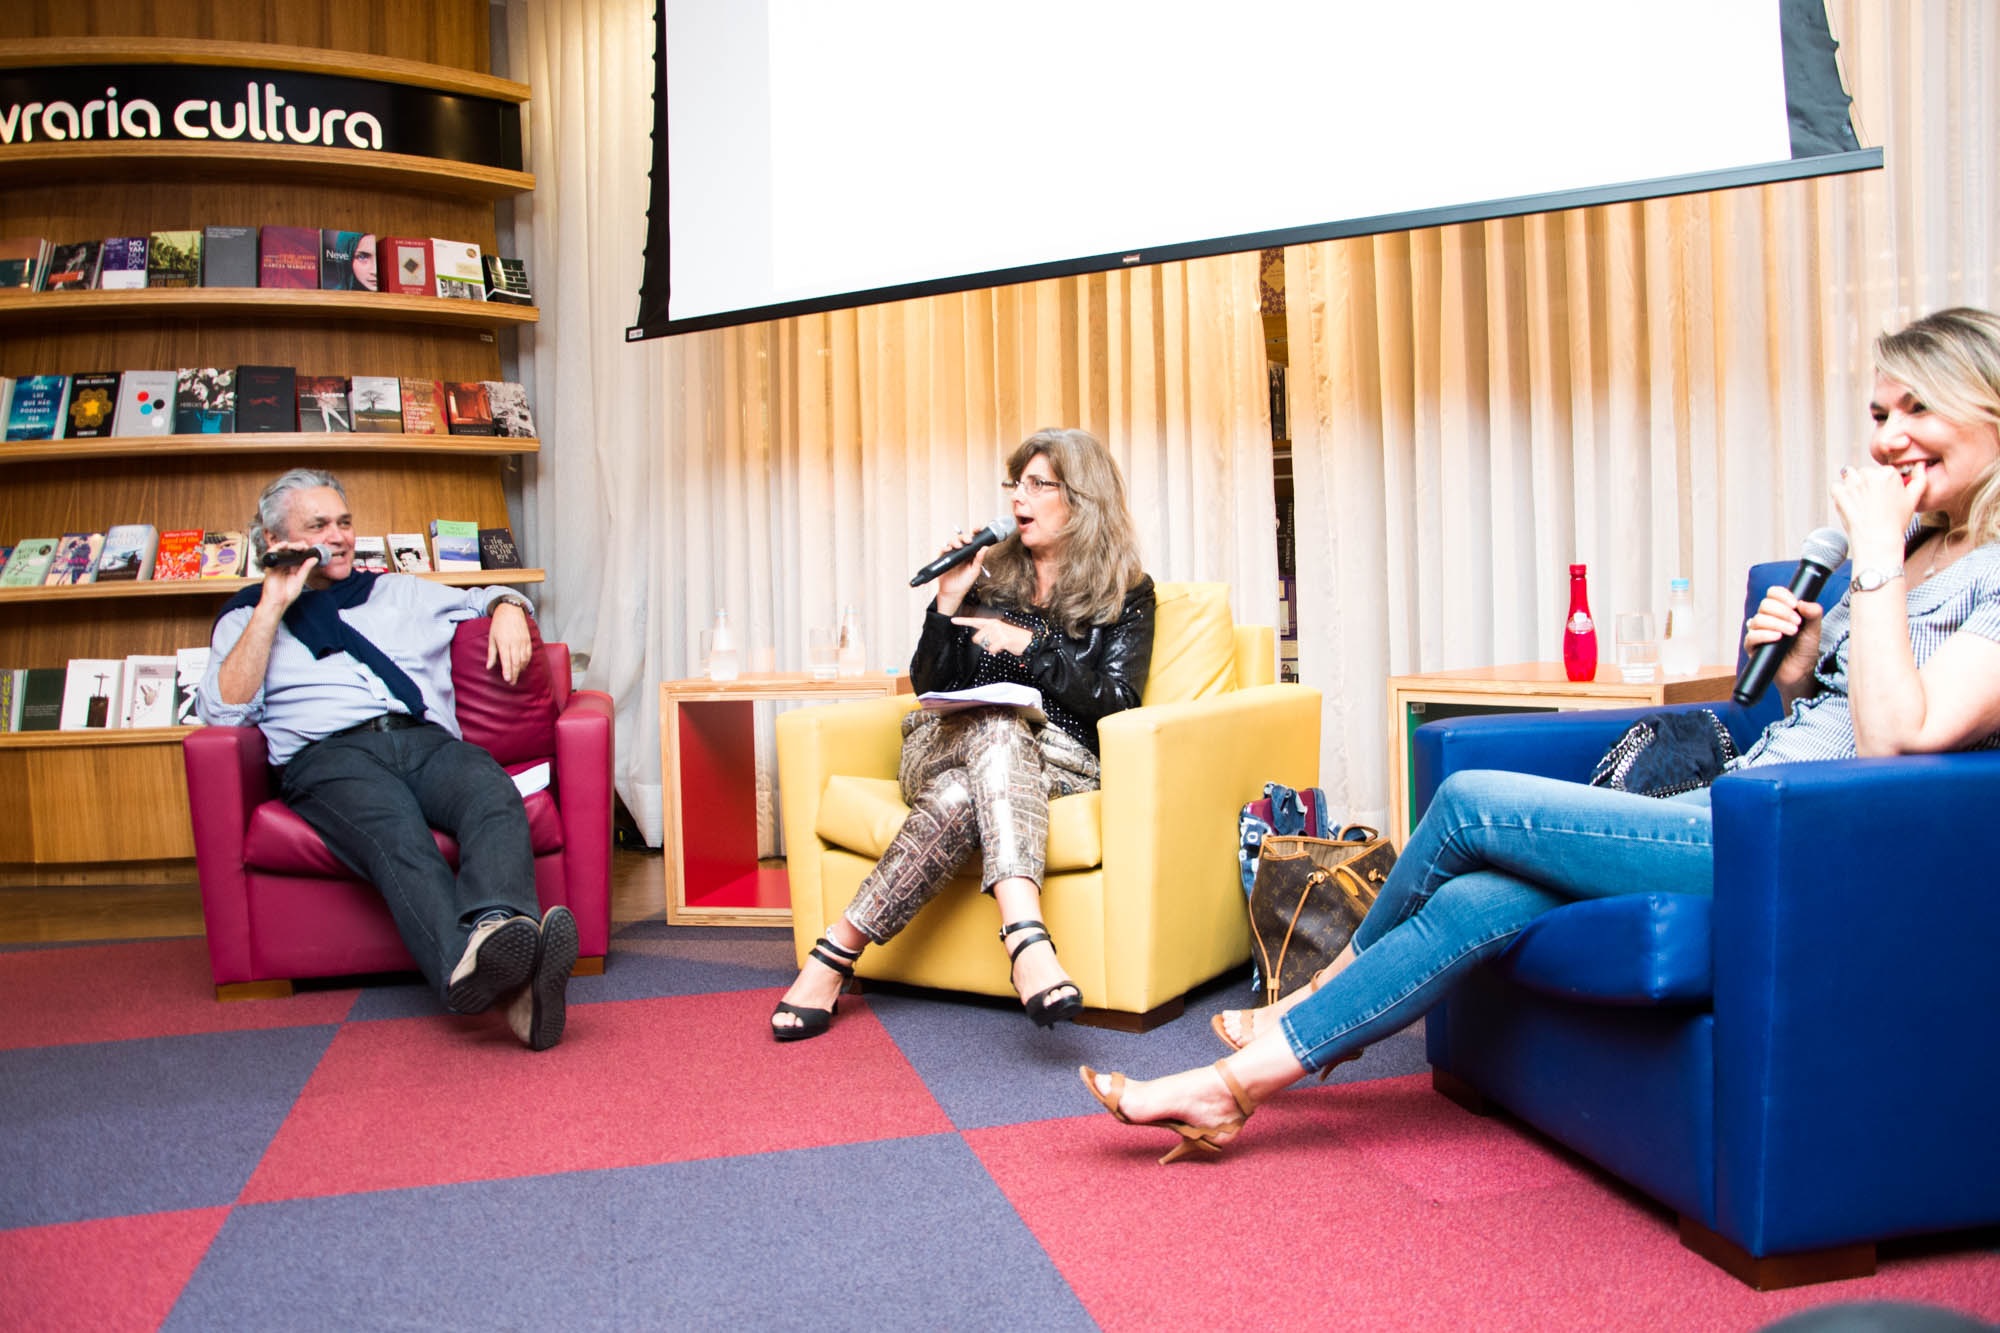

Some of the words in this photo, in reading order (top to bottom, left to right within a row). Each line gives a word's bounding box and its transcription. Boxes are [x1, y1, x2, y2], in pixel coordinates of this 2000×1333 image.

[0, 87, 160, 144] vraria
[173, 81, 383, 150] cultura
[326, 249, 350, 260] Neve
